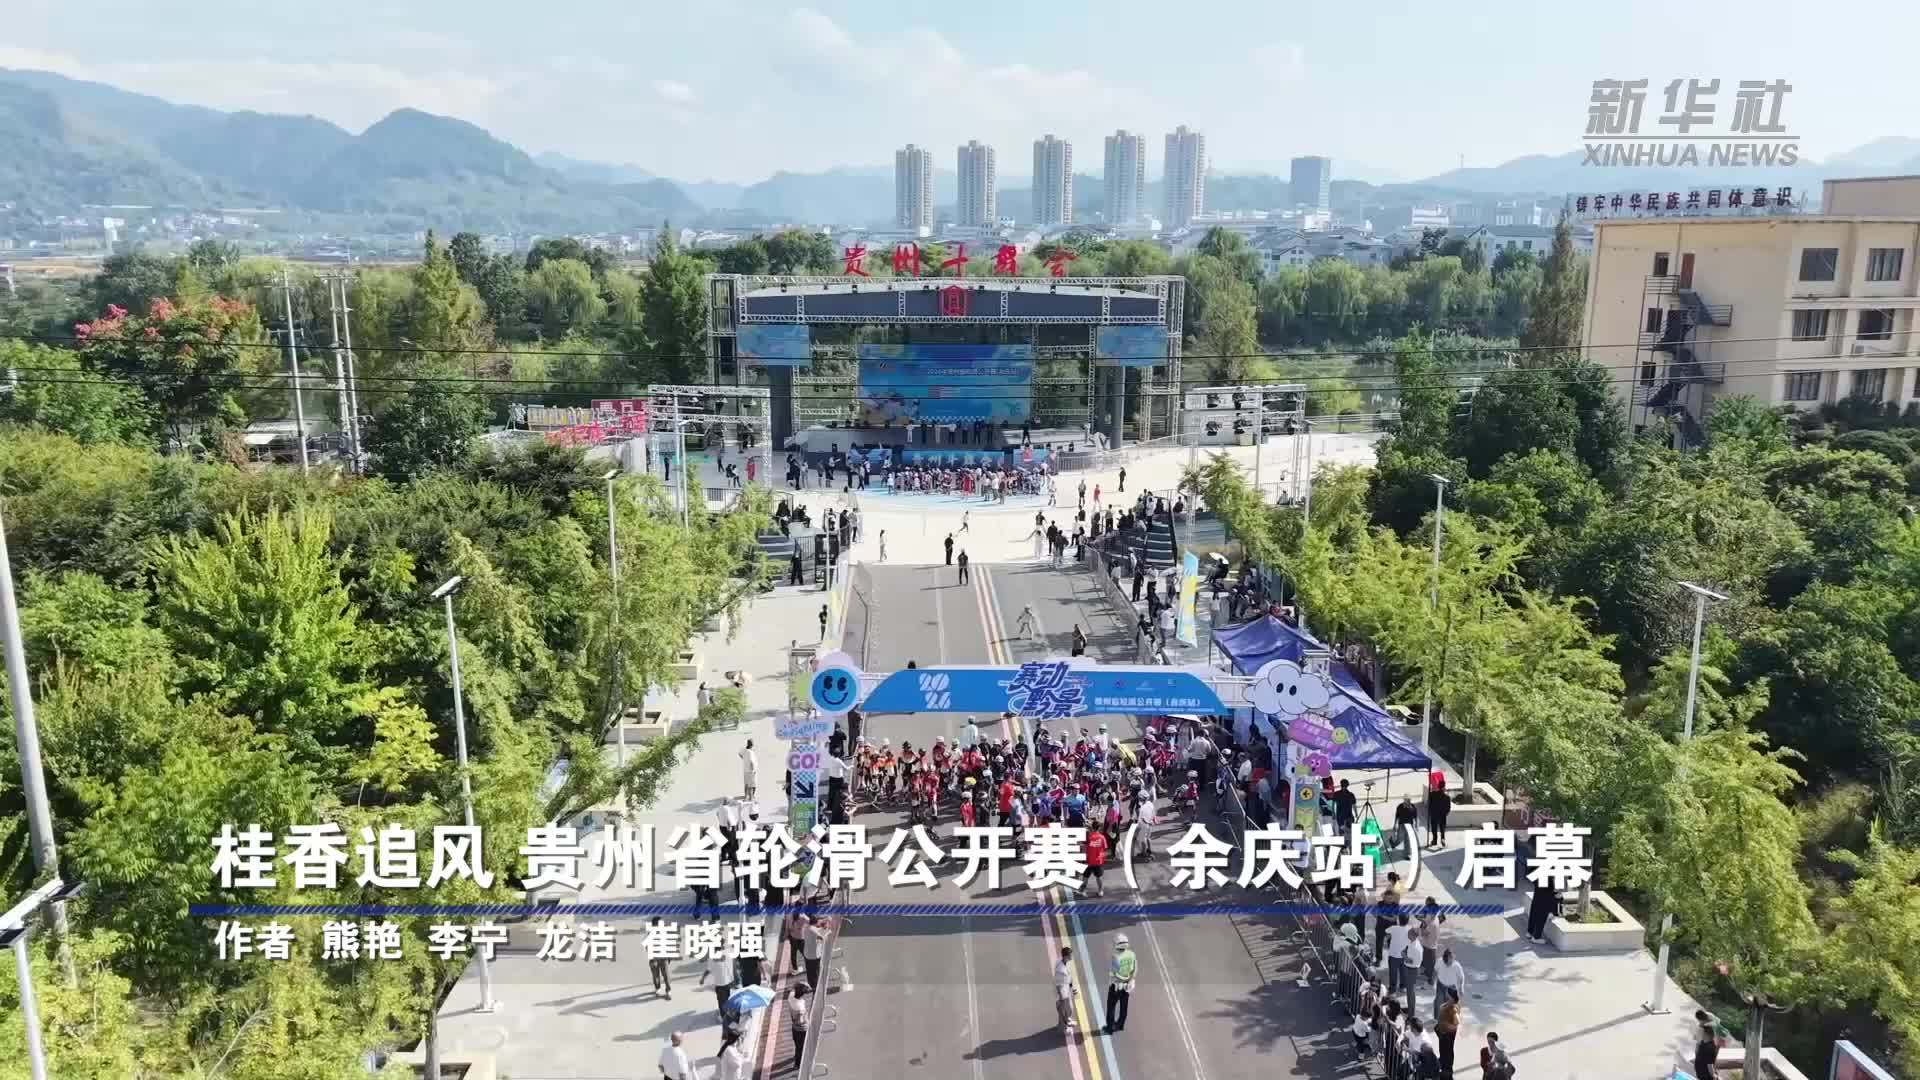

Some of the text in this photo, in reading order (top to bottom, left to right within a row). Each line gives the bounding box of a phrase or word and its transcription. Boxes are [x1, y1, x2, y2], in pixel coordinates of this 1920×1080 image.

[1575, 186, 1793, 214] 铸牢中华民族共同体意识
[1008, 661, 1069, 693] 赛动
[788, 752, 820, 769] GO!
